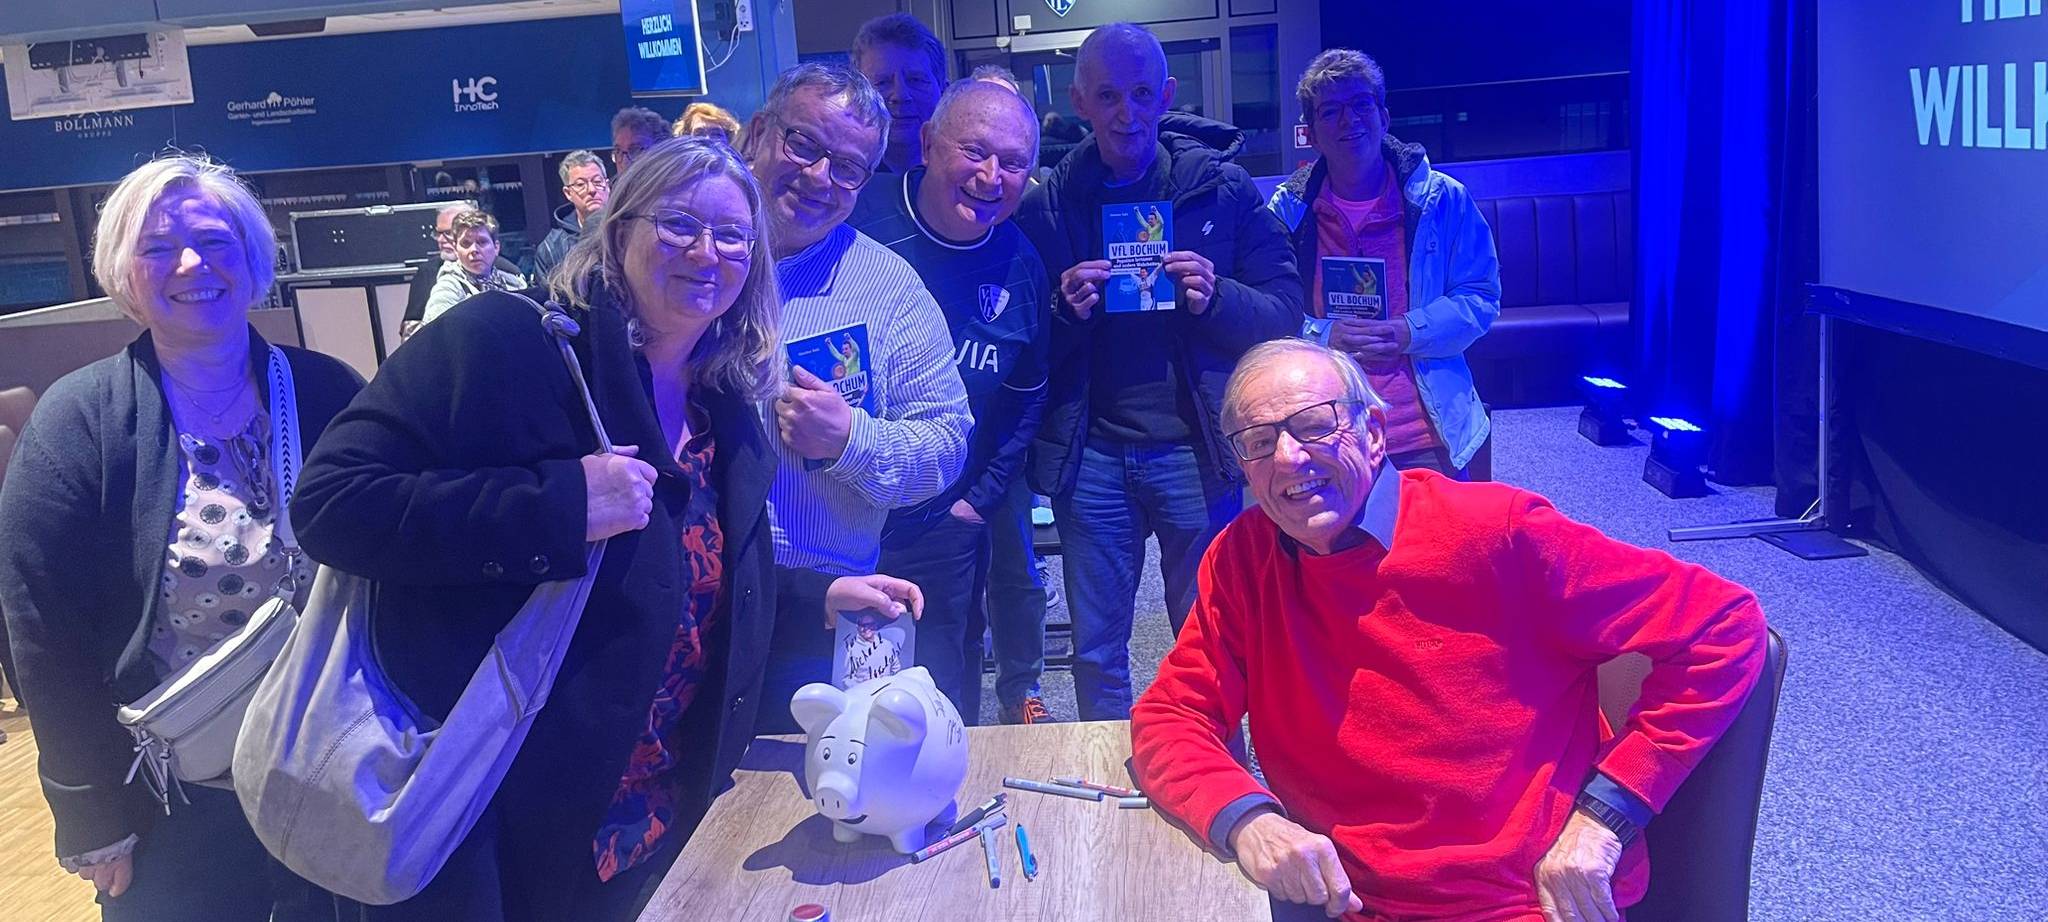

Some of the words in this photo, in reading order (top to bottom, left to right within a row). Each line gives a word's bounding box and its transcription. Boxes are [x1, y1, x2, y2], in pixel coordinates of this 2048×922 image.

[641, 14, 673, 35] HERZLICH
[638, 37, 682, 59] WILLKOMMEN
[453, 76, 498, 103] HC
[227, 100, 266, 112] Gerhard
[283, 97, 315, 107] Pöhler
[454, 101, 499, 112] InnoTech
[55, 115, 134, 132] BOLLMANN
[1111, 245, 1127, 257] VfL
[1130, 243, 1166, 256] BOCHUM
[1346, 295, 1380, 306] BOCHUM
[832, 374, 866, 394] OCHUM
